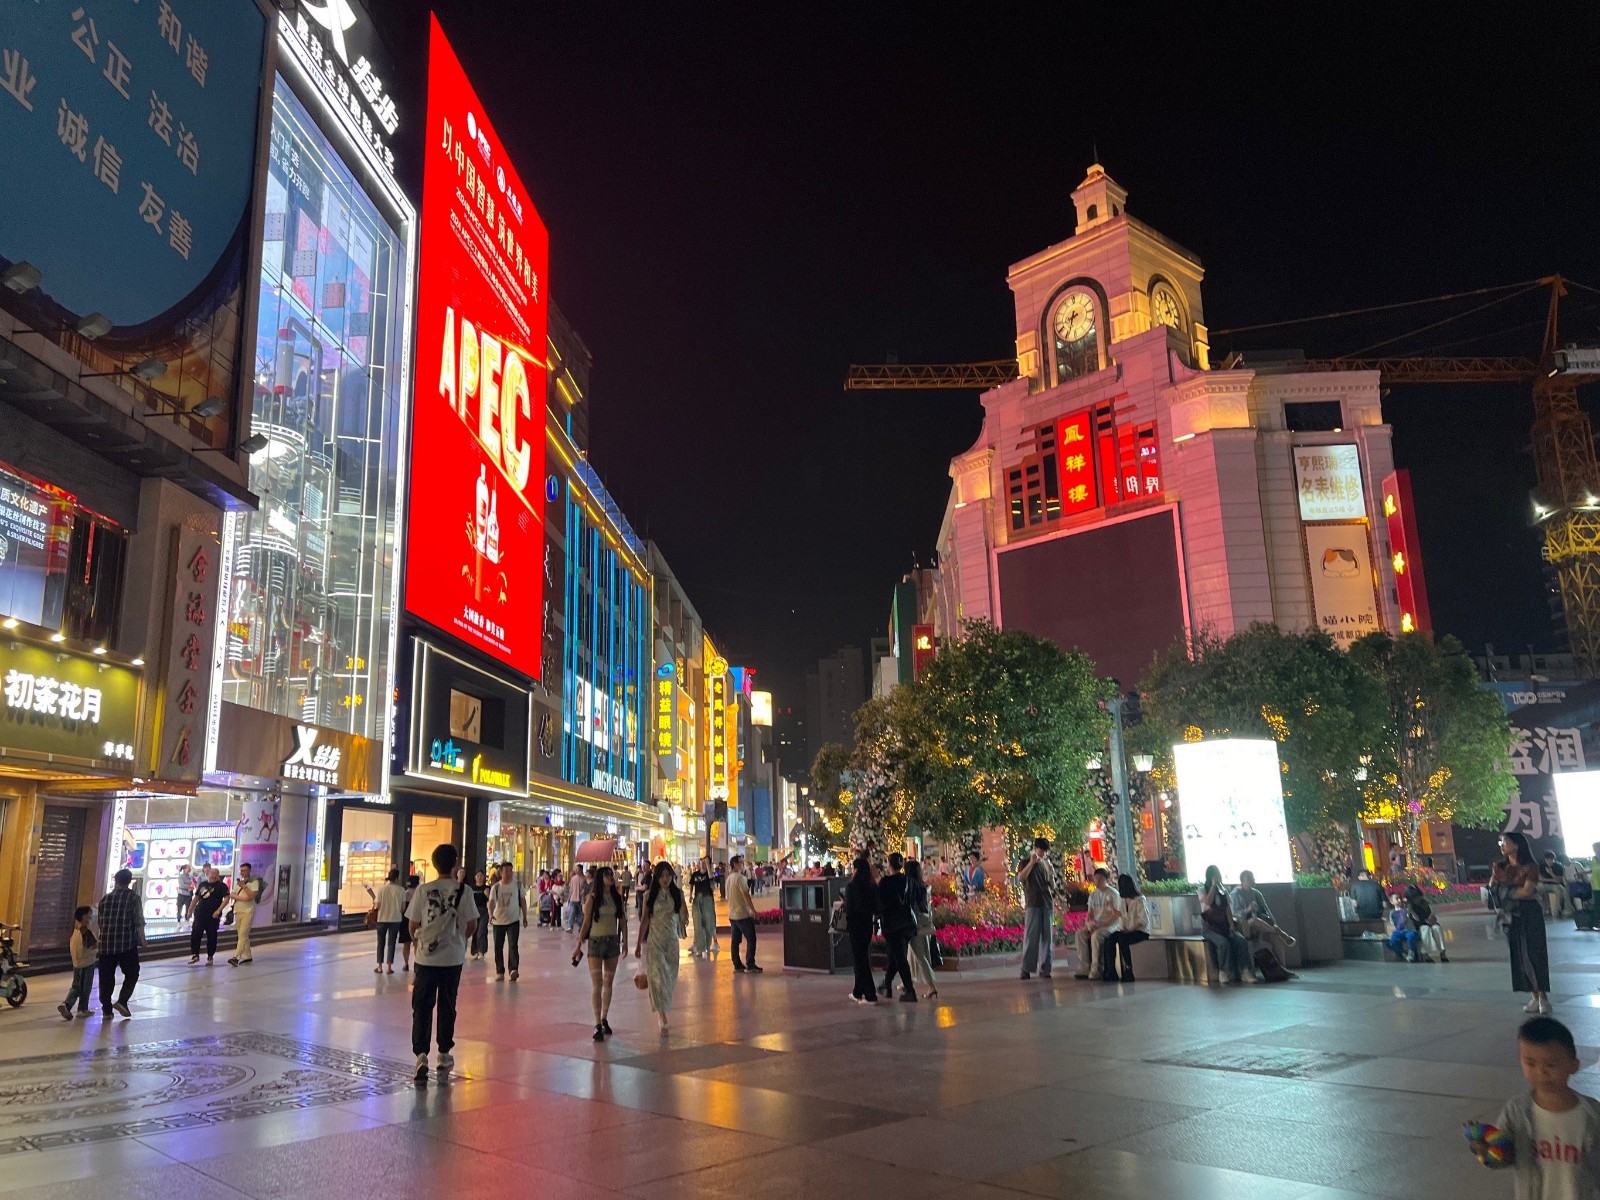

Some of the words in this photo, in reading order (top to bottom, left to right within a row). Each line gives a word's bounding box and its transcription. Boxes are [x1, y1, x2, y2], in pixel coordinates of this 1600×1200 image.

[159, 0, 208, 88] 和谐
[71, 7, 132, 100] 公正
[148, 90, 199, 176] 法治
[57, 98, 123, 195] 诚信
[138, 182, 193, 261] 友善
[442, 117, 494, 230] 以中国智慧
[498, 212, 537, 303] 筑世界和美
[439, 305, 531, 492] APEC
[1301, 474, 1360, 504] 名表维修
[1323, 613, 1373, 625] 猫小院
[4, 670, 102, 724] 初茶花月
[659, 681, 672, 747] 精益眼镜
[613, 775, 635, 800] GLASSES
